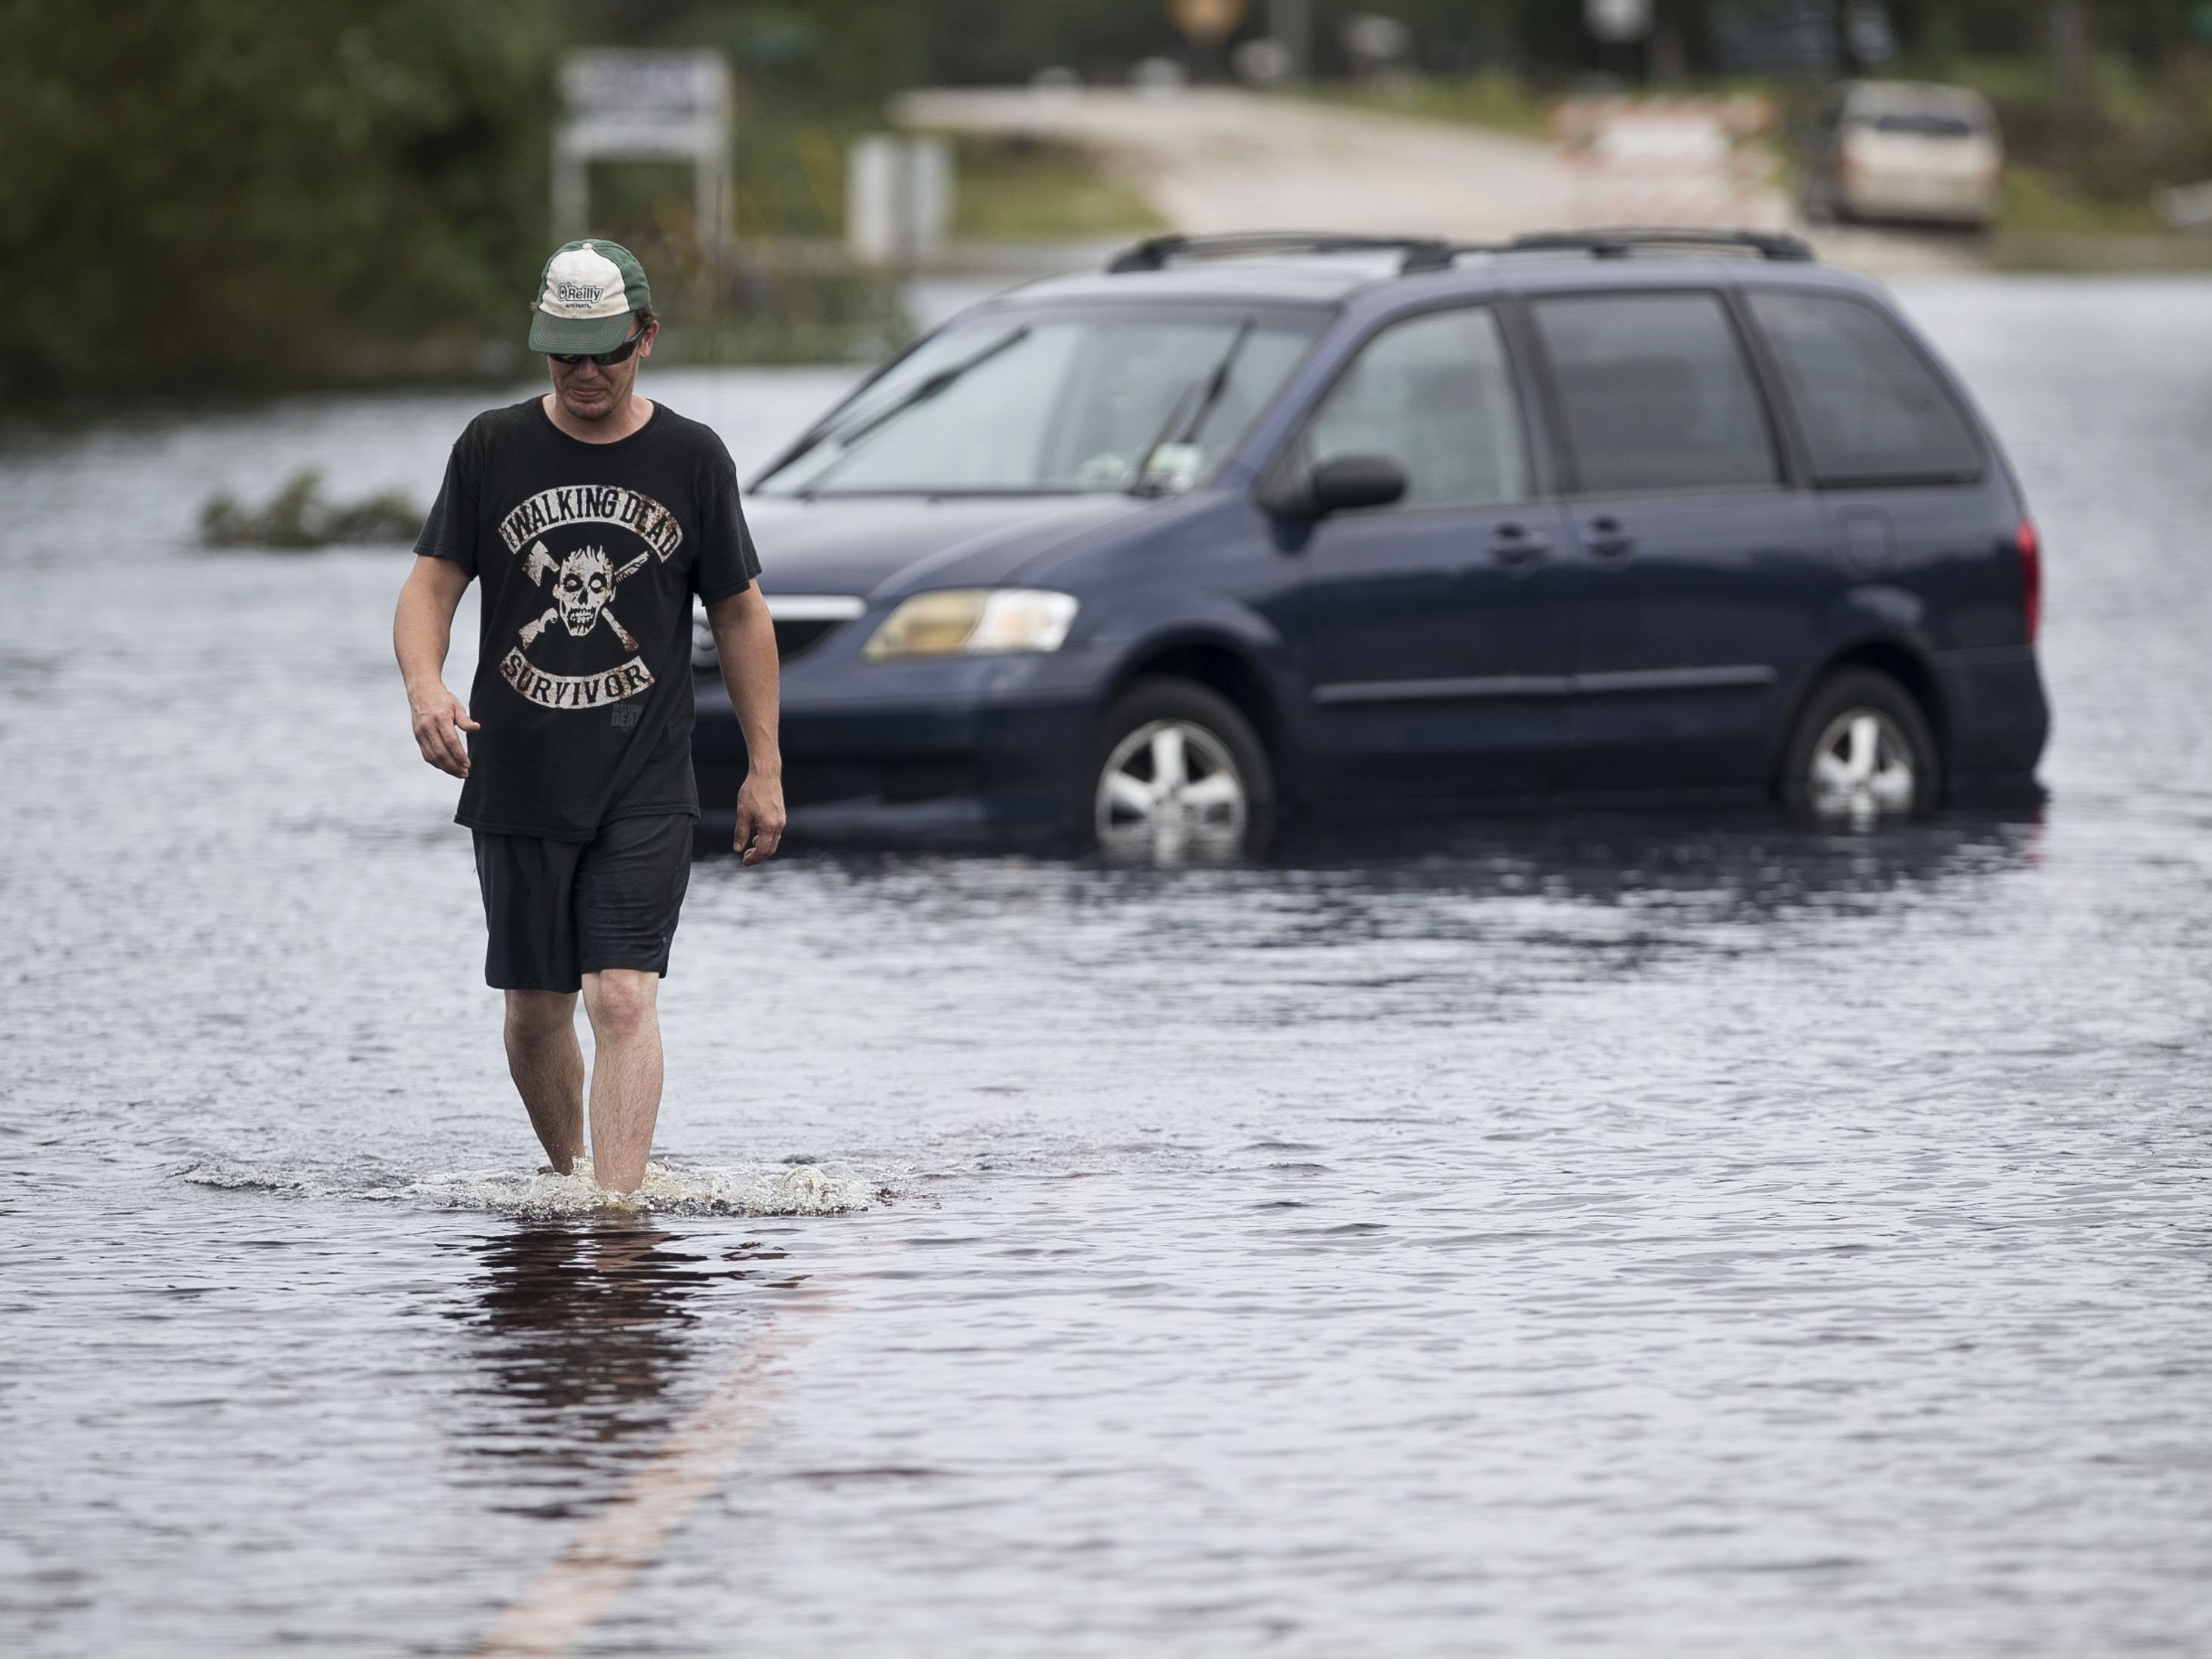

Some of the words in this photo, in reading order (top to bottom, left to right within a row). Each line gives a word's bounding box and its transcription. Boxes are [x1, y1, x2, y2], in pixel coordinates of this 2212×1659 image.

[559, 283, 601, 301] O'Reilly
[506, 487, 619, 542] WALKING
[620, 492, 681, 557] DEAD
[504, 655, 648, 706] SURVIVOR
